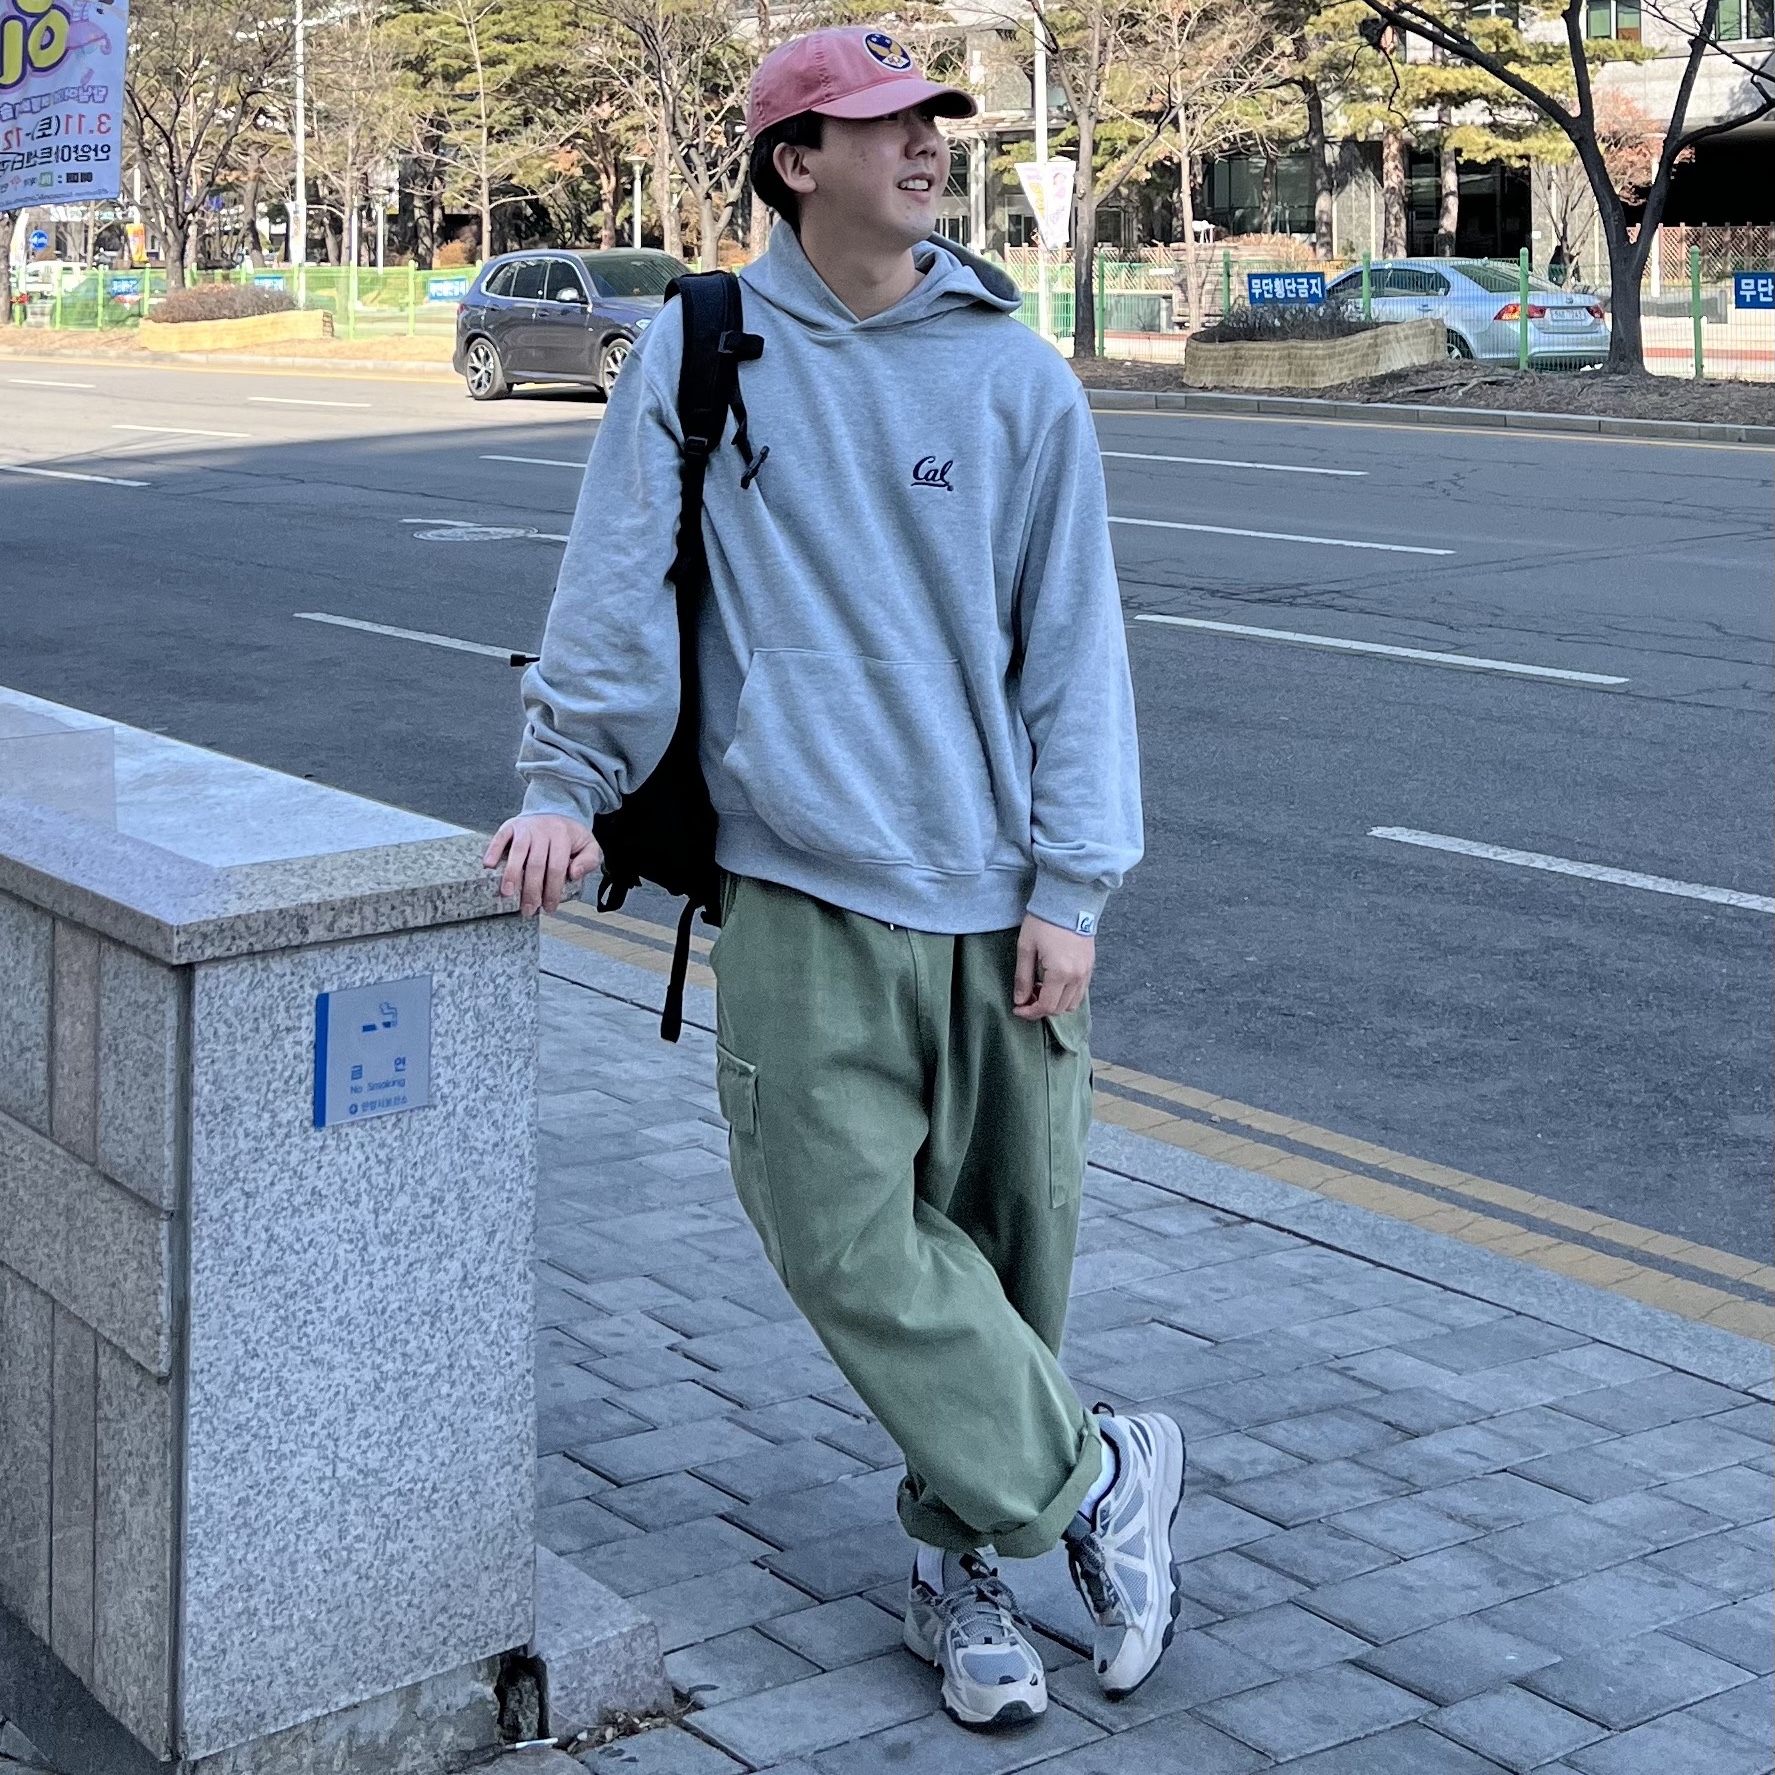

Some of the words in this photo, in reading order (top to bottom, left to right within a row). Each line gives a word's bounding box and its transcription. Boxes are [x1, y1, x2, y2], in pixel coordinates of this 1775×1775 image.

[1251, 277, 1323, 299] 무단횡단금지
[911, 456, 954, 491] Cal
[351, 1085, 363, 1094] No
[367, 1078, 406, 1092] Smoking
